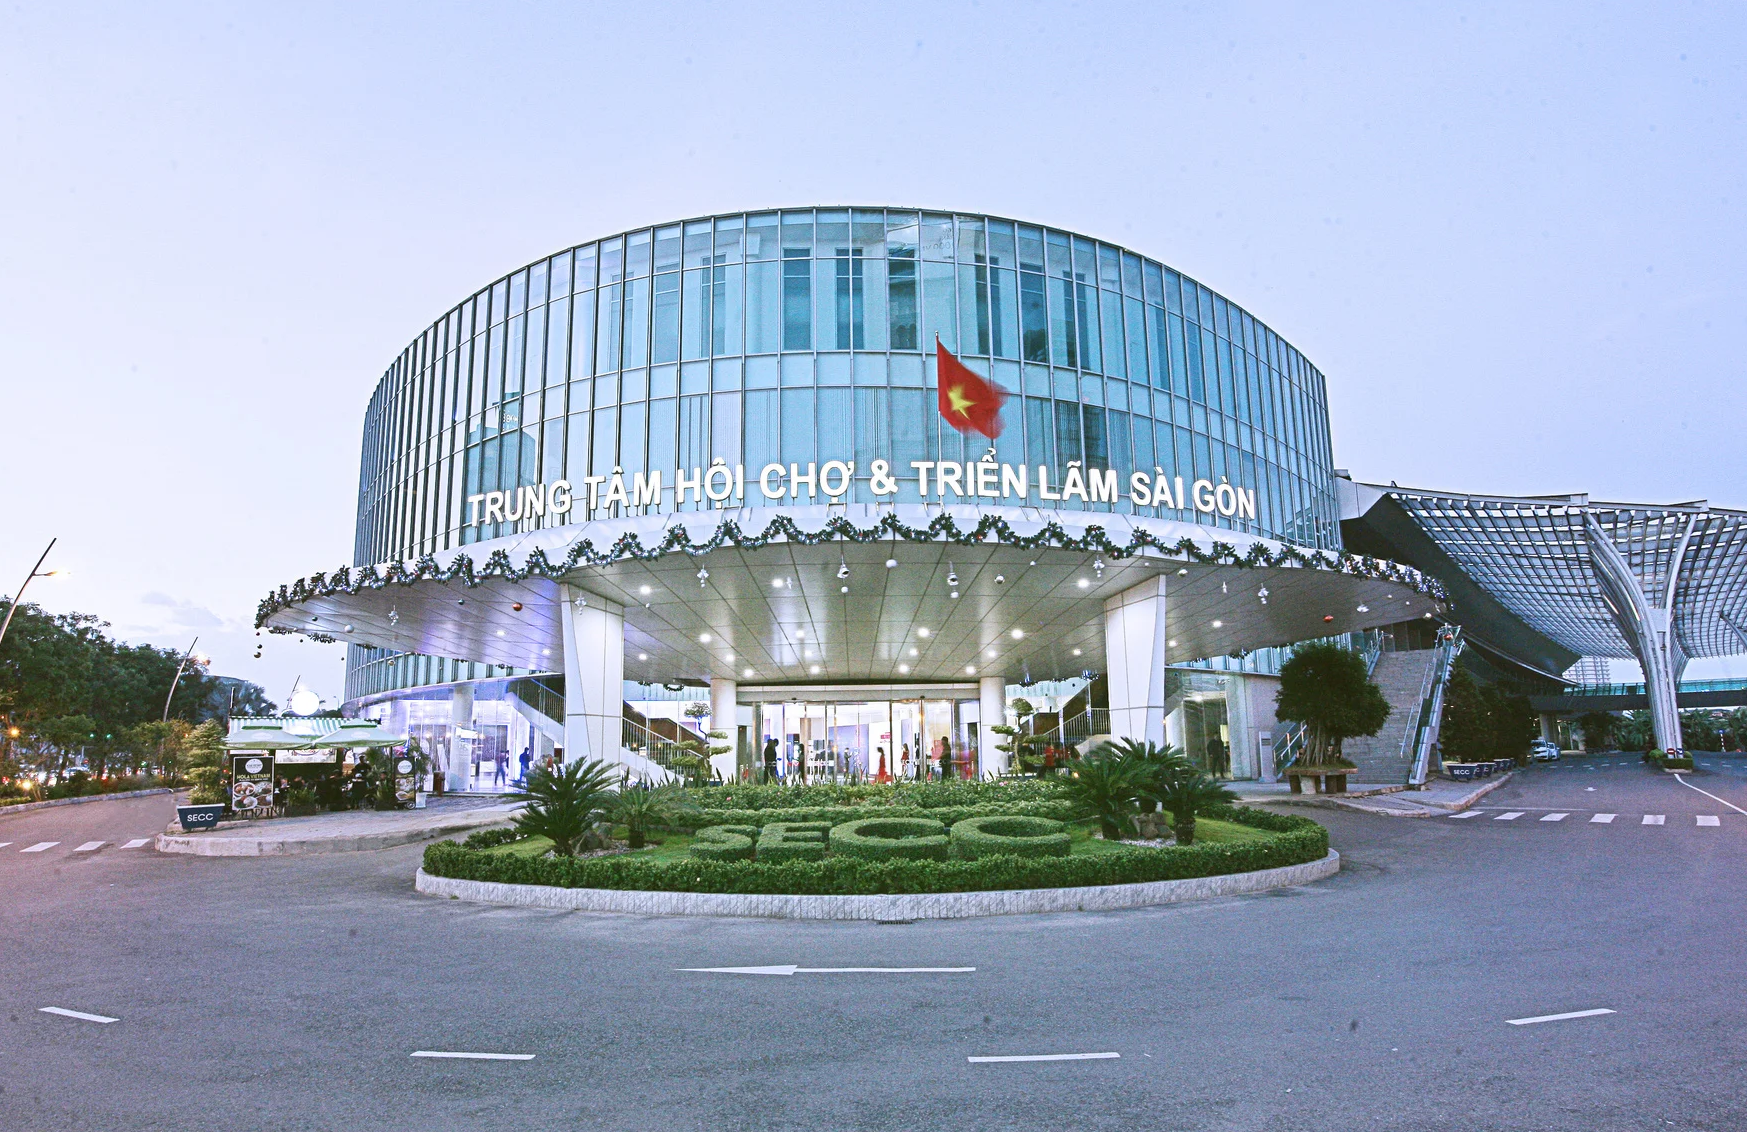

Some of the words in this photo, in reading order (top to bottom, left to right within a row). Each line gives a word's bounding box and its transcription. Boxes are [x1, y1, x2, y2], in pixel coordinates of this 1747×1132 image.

[467, 481, 572, 527] TRUNG
[584, 465, 661, 511] TÂM
[676, 456, 744, 510] HỘI
[759, 460, 855, 504] CHỢ
[869, 459, 898, 496] &
[910, 447, 1027, 500] TRIỂN
[1038, 460, 1118, 504] LÃM
[1130, 466, 1184, 510] SÀI
[1192, 475, 1255, 520] GÒN
[187, 813, 214, 822] SECC
[690, 815, 1071, 861] SECC
